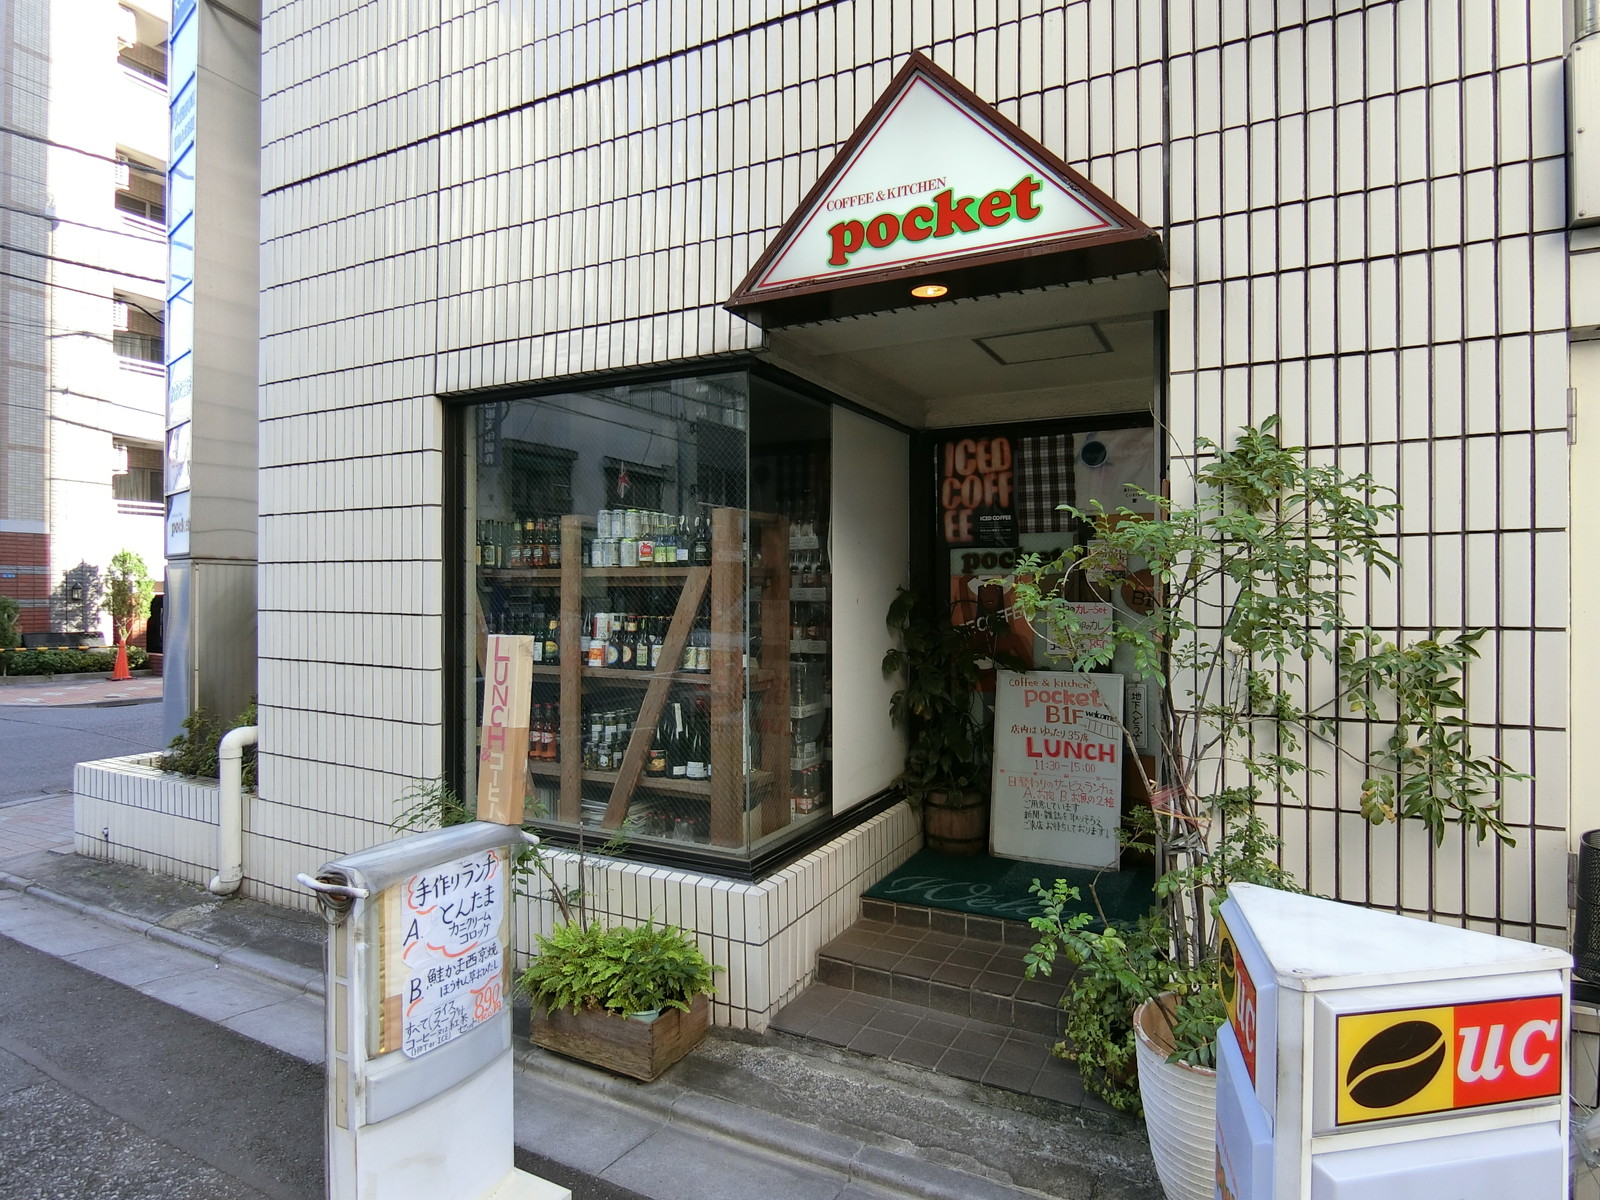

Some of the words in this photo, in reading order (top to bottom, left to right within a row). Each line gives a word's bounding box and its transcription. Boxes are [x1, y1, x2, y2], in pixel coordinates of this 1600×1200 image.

[826, 192, 874, 212] COFFEE
[876, 190, 886, 202] &
[887, 176, 947, 199] KITCHEN
[827, 174, 1043, 267] pocket
[944, 438, 1012, 477] ICED
[941, 471, 1013, 510] COFF
[944, 509, 974, 542] EE
[487, 636, 511, 752] LUNCH
[1024, 688, 1104, 708] pocket
[1042, 678, 1050, 687] &
[1054, 678, 1089, 689] kitchen
[1045, 704, 1085, 725] B1F
[1131, 691, 1143, 742] 地下へどうぞ
[1025, 736, 1116, 763] LUNCH
[416, 854, 496, 906] 手作りランチ
[440, 885, 494, 924] とんたま
[448, 912, 492, 937] カニクリーム
[460, 923, 490, 945] コロッケ
